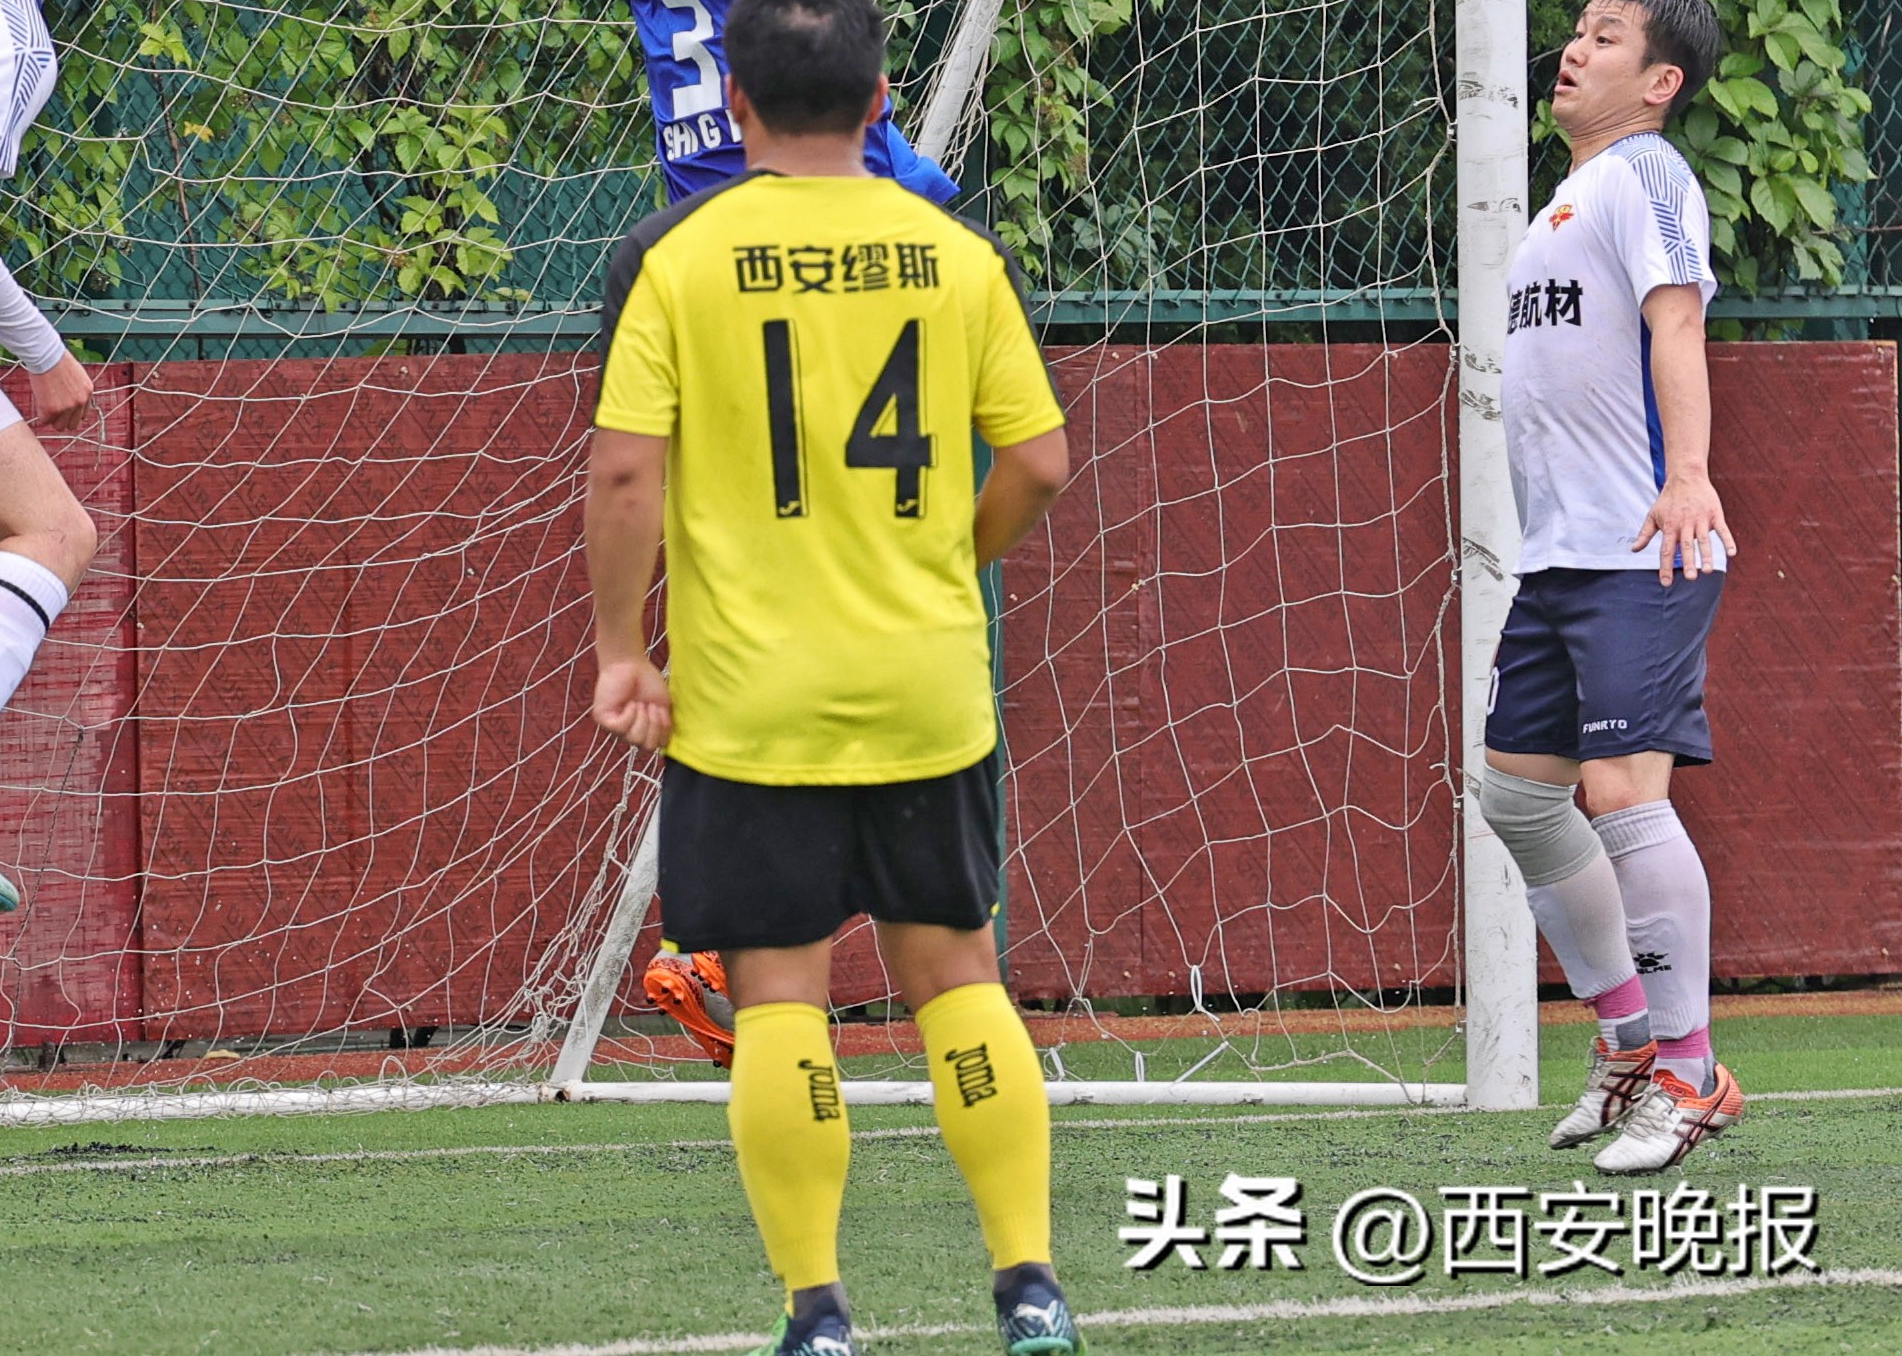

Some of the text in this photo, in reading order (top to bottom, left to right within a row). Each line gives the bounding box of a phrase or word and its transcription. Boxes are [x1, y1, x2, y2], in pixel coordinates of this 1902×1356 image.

[733, 243, 940, 294] 西安缪斯
[762, 318, 938, 520] 14
